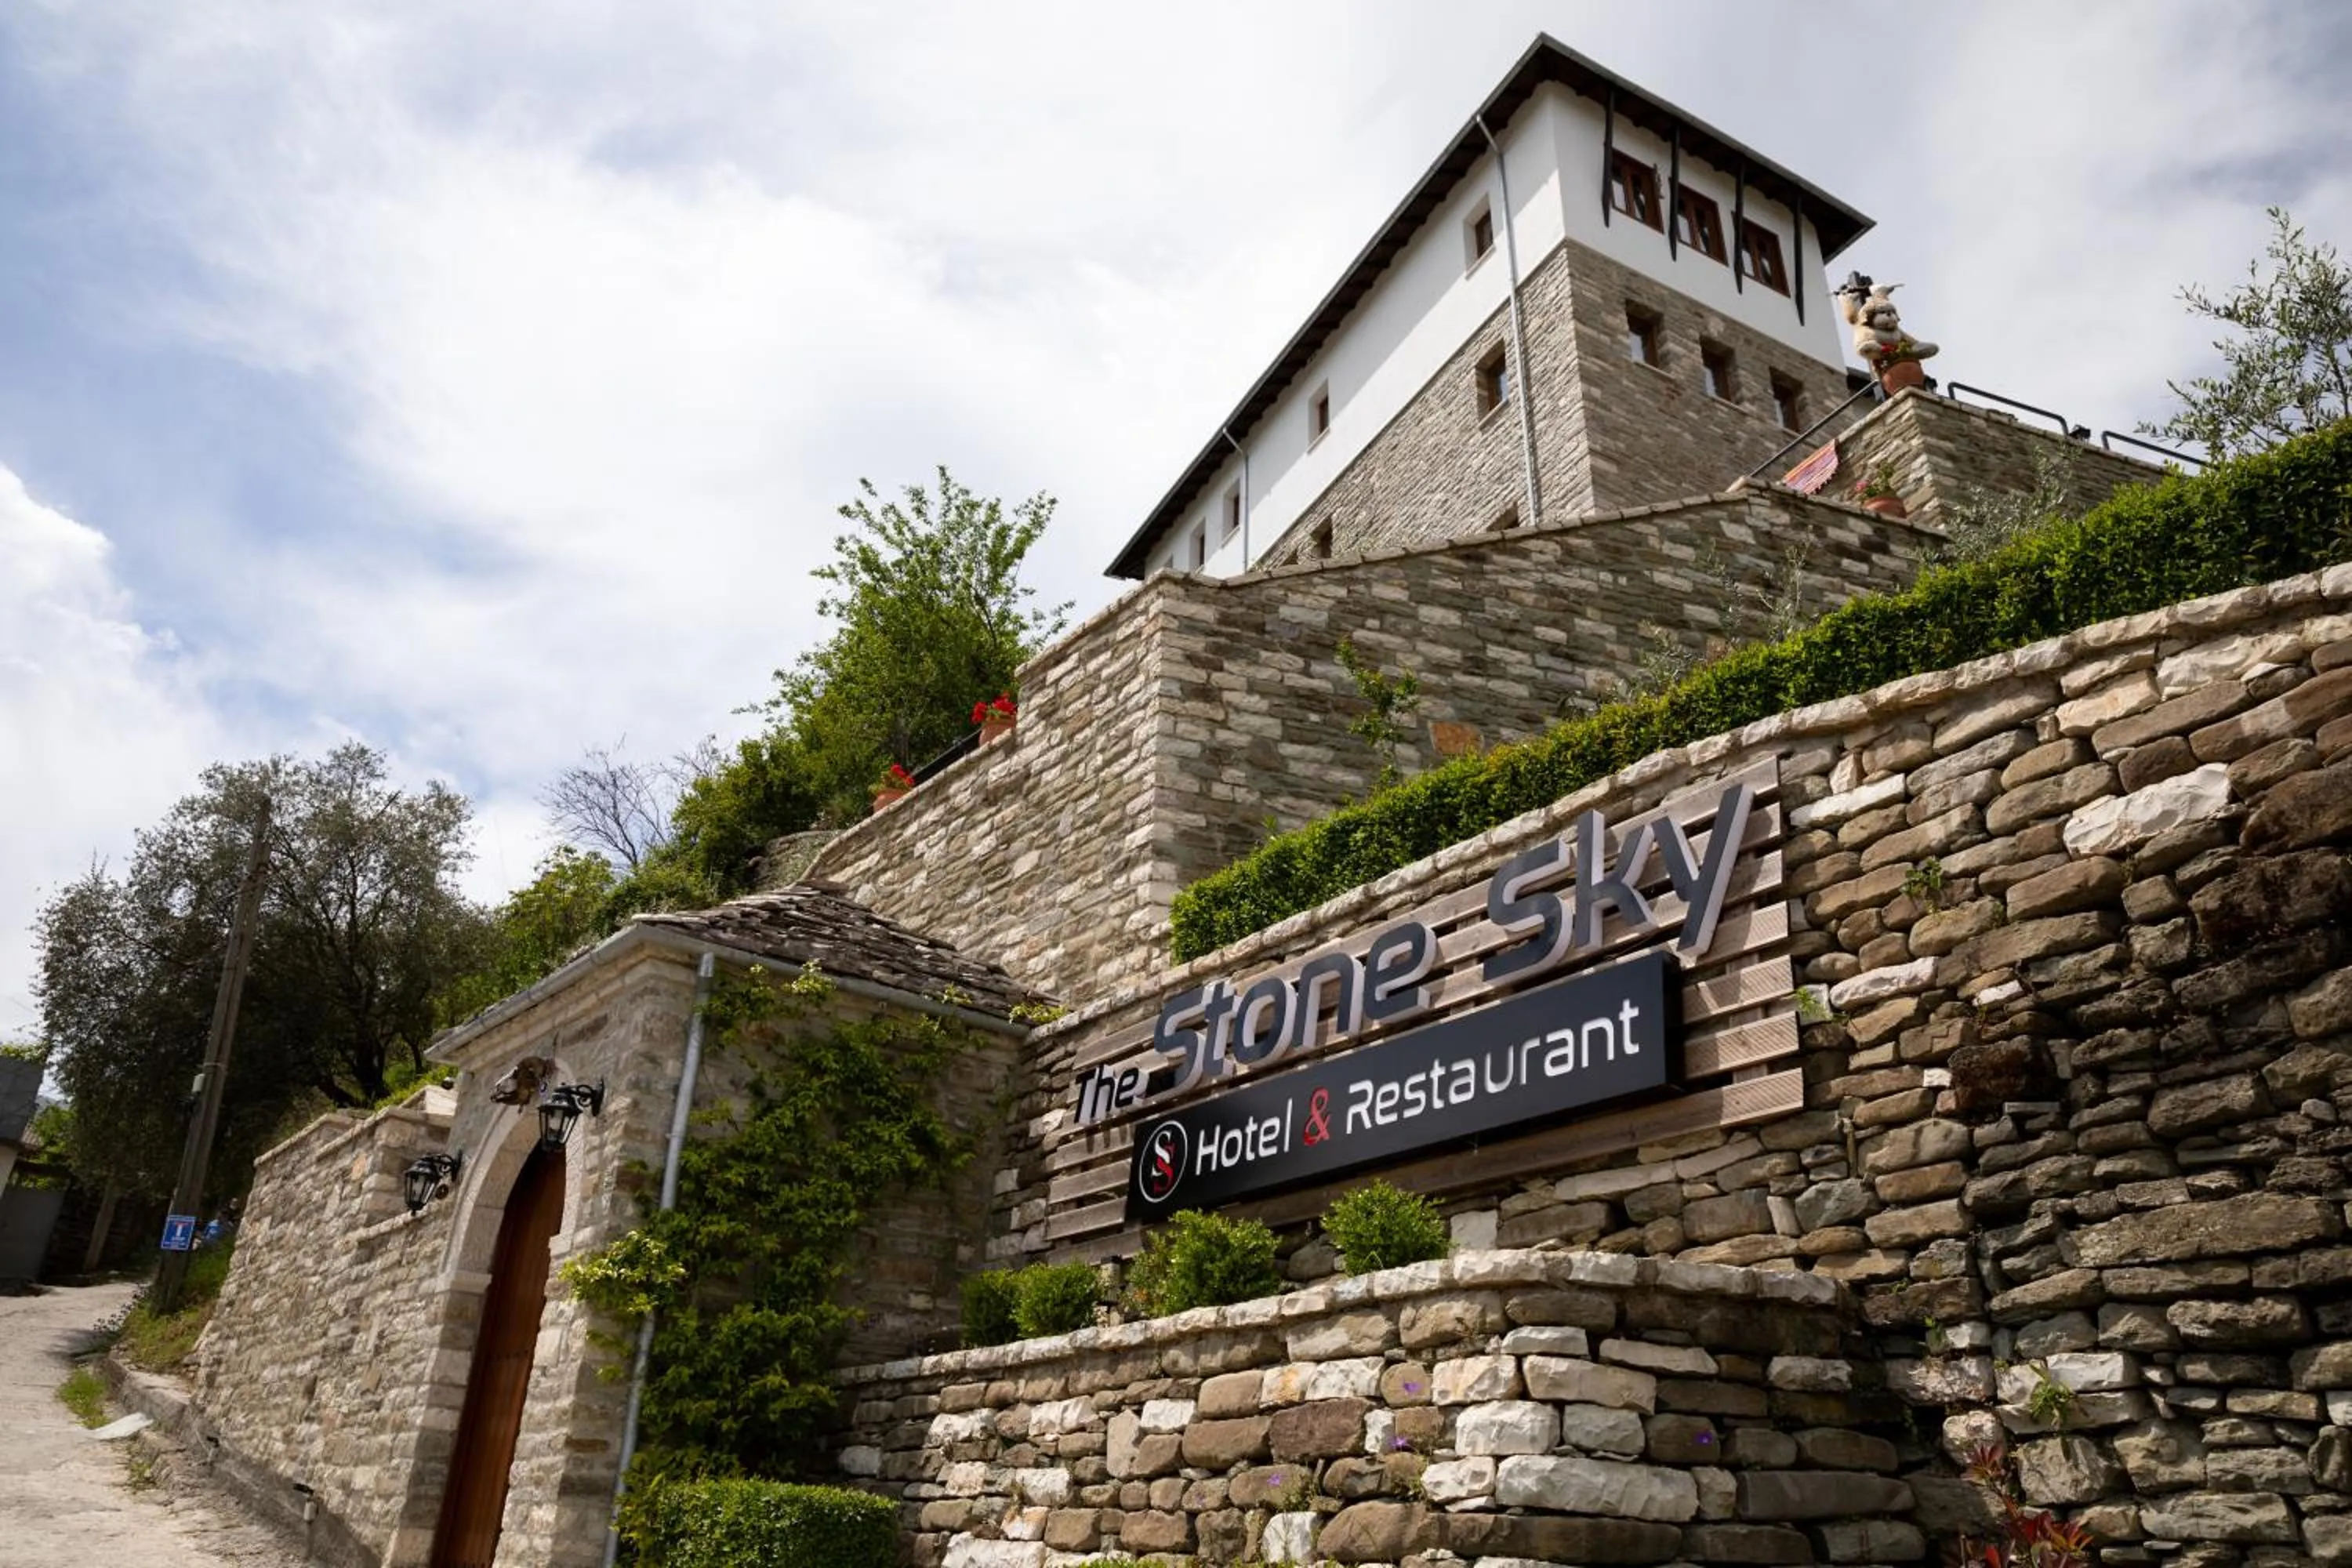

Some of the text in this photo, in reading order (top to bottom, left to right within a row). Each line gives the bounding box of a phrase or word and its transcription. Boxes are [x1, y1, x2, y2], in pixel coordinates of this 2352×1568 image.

[1074, 784, 1754, 1124] The Stone Sky
[1196, 998, 1640, 1176] Hotel & Restaurant
